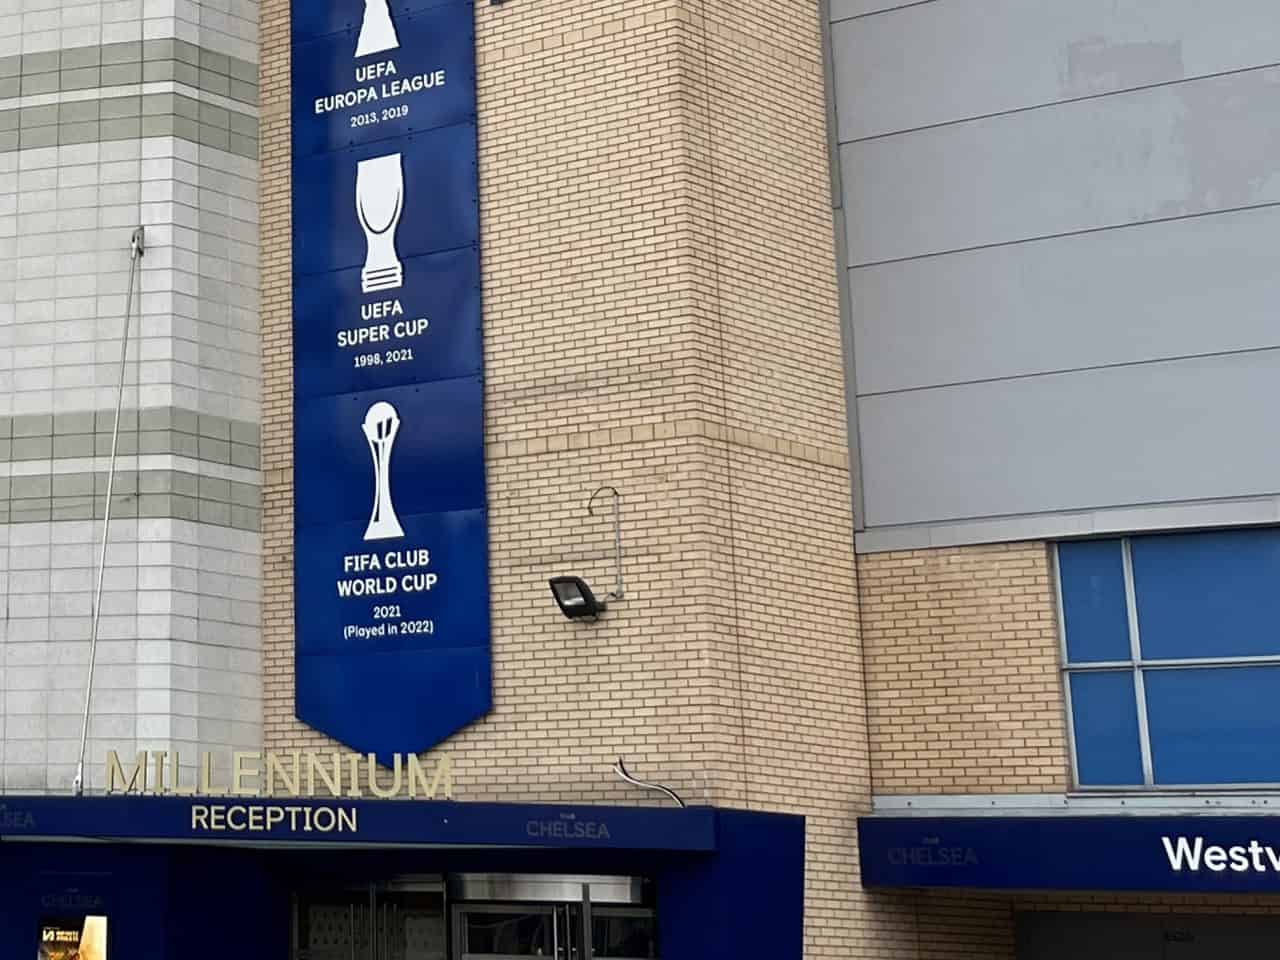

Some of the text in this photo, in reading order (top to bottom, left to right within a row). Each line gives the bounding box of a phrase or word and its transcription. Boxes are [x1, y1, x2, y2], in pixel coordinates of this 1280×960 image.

[355, 60, 397, 82] UEFA
[314, 70, 445, 114] EUROPA LEAGUE
[350, 104, 409, 128] 2013, 2019
[361, 299, 403, 320] UEFA
[337, 318, 429, 347] SUPER CUP
[354, 348, 414, 368] 1998, 2021
[344, 549, 430, 573] FIFA CLUB
[337, 573, 438, 597] WORLD CUP
[373, 605, 401, 619] 2021
[343, 620, 434, 640] (Played in 2022)
[106, 749, 454, 798] MILLENNIUM
[191, 805, 358, 832] RECEPTION
[527, 820, 610, 838] CHELSEA
